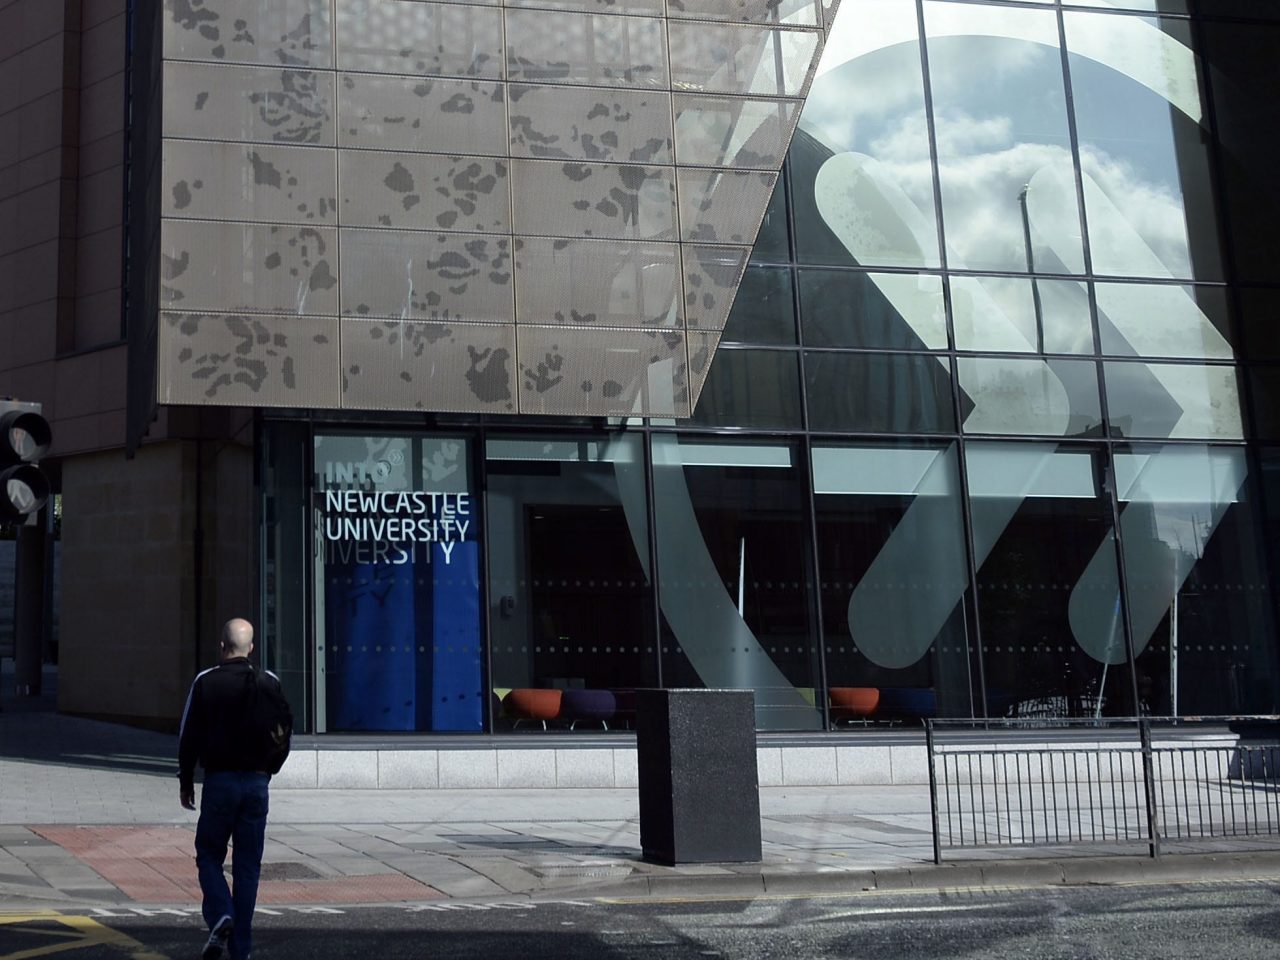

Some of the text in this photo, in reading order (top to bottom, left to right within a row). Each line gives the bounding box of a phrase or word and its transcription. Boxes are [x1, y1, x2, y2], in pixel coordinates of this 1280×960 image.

[325, 460, 392, 484] INTO
[325, 490, 470, 515] NEWCASTLE
[325, 517, 470, 543] UNIVERSITY
